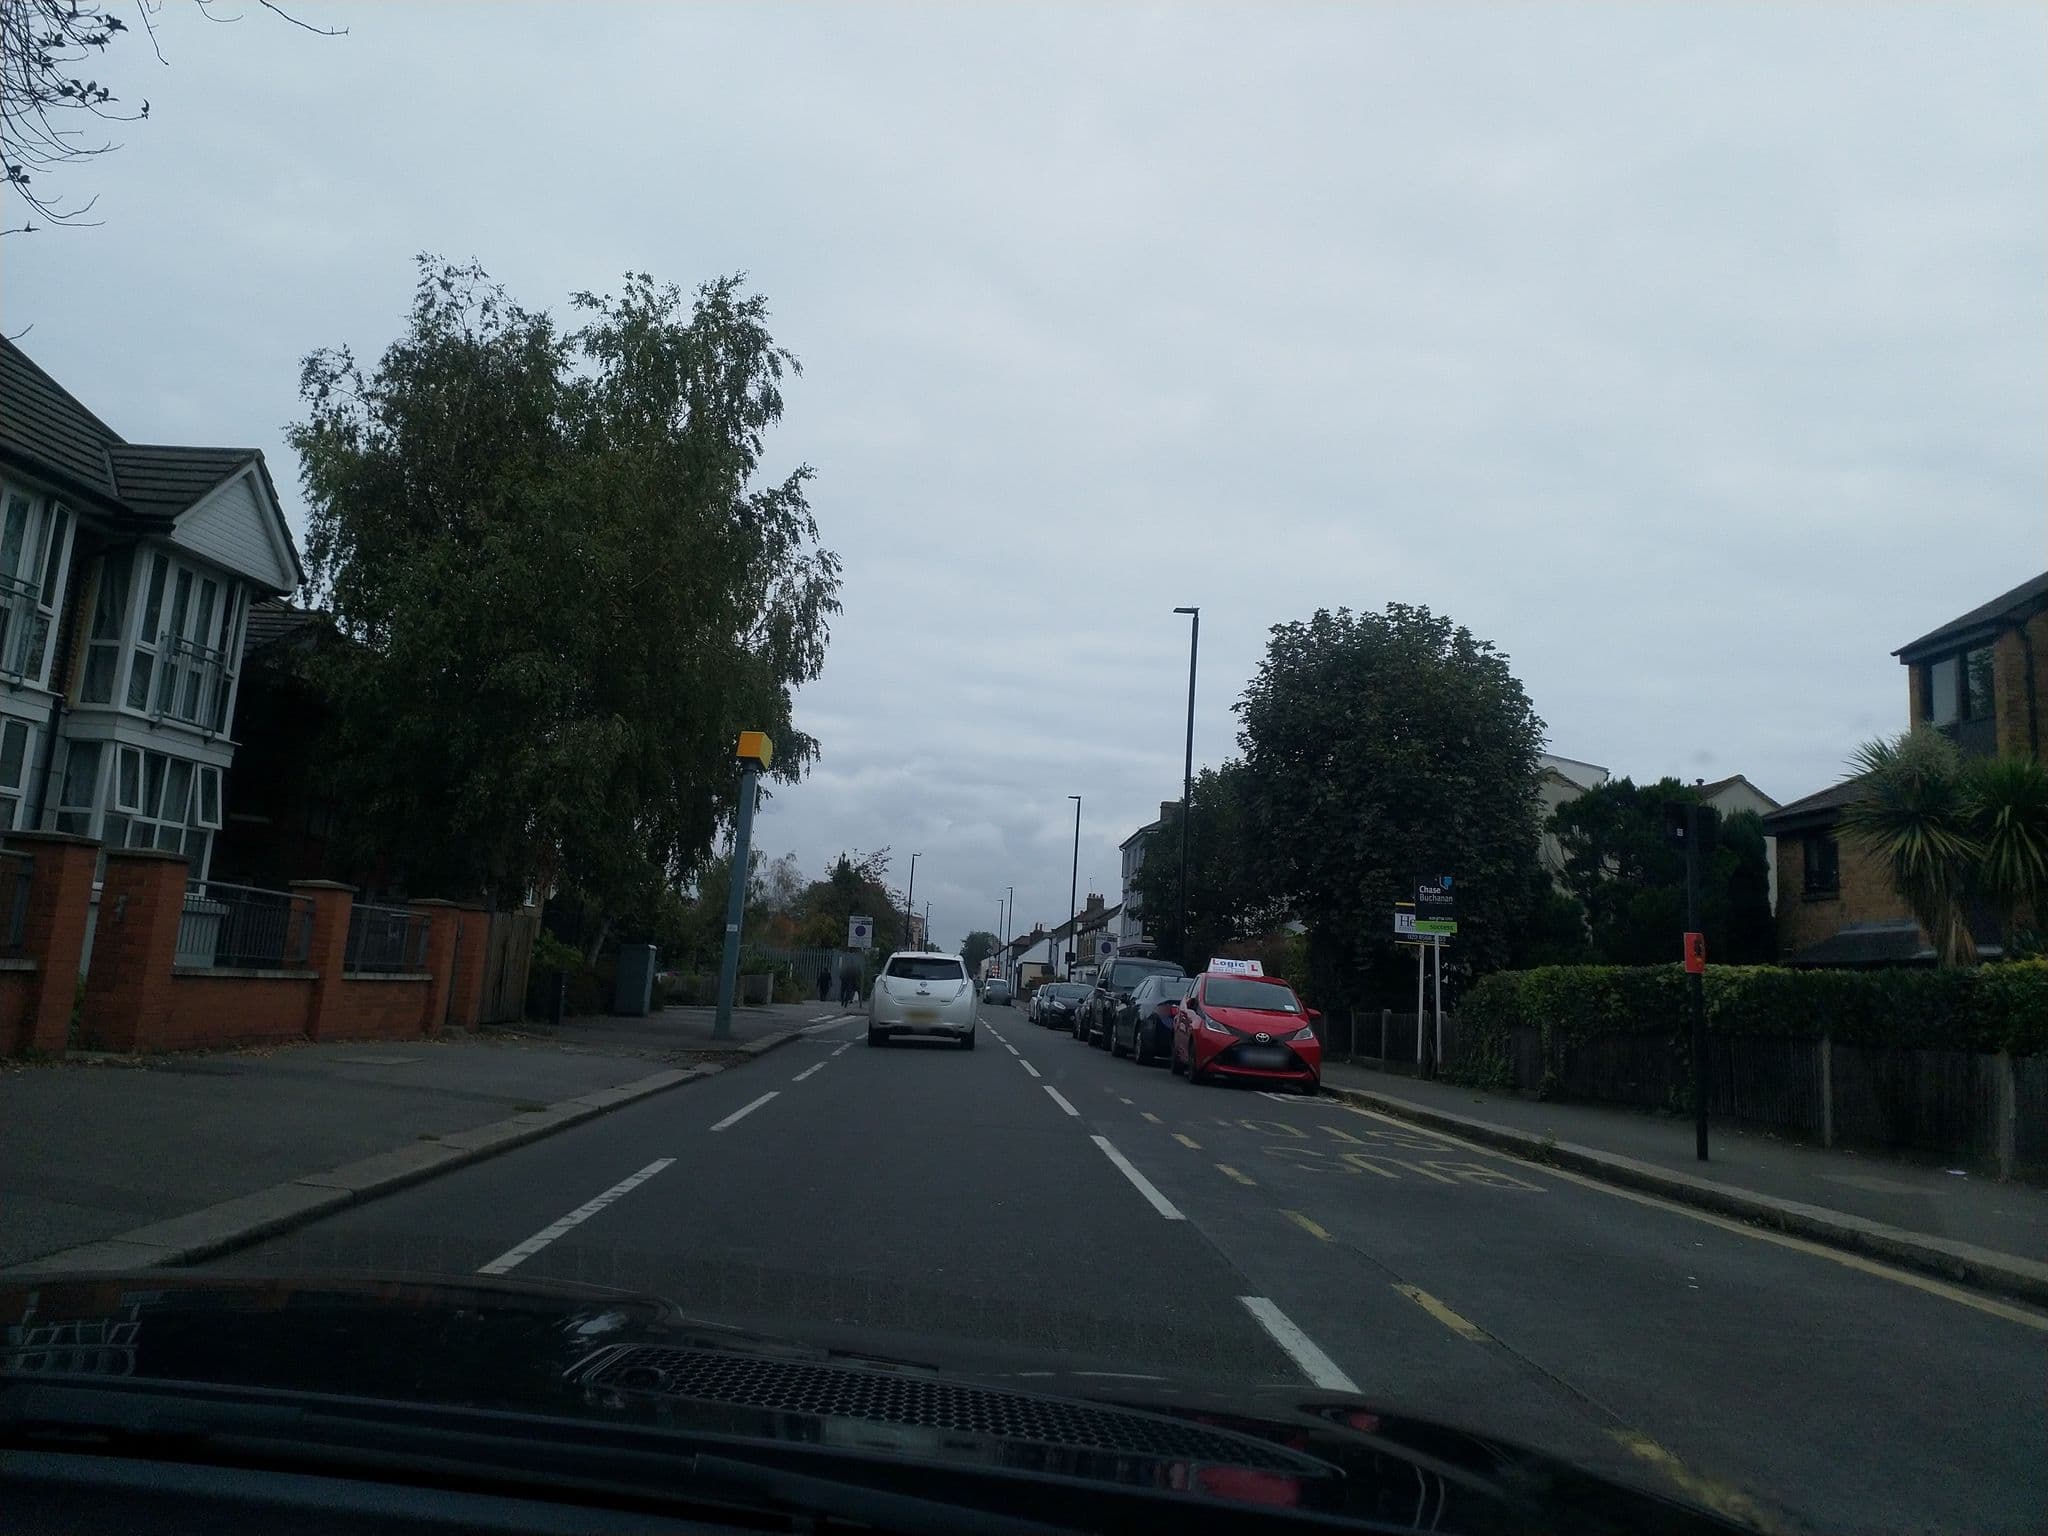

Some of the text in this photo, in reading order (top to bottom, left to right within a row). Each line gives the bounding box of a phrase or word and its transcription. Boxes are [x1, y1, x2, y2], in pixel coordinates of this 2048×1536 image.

[1419, 885, 1441, 894] Chase
[1419, 893, 1454, 902] Buchanan
[1212, 959, 1245, 968] Logic
